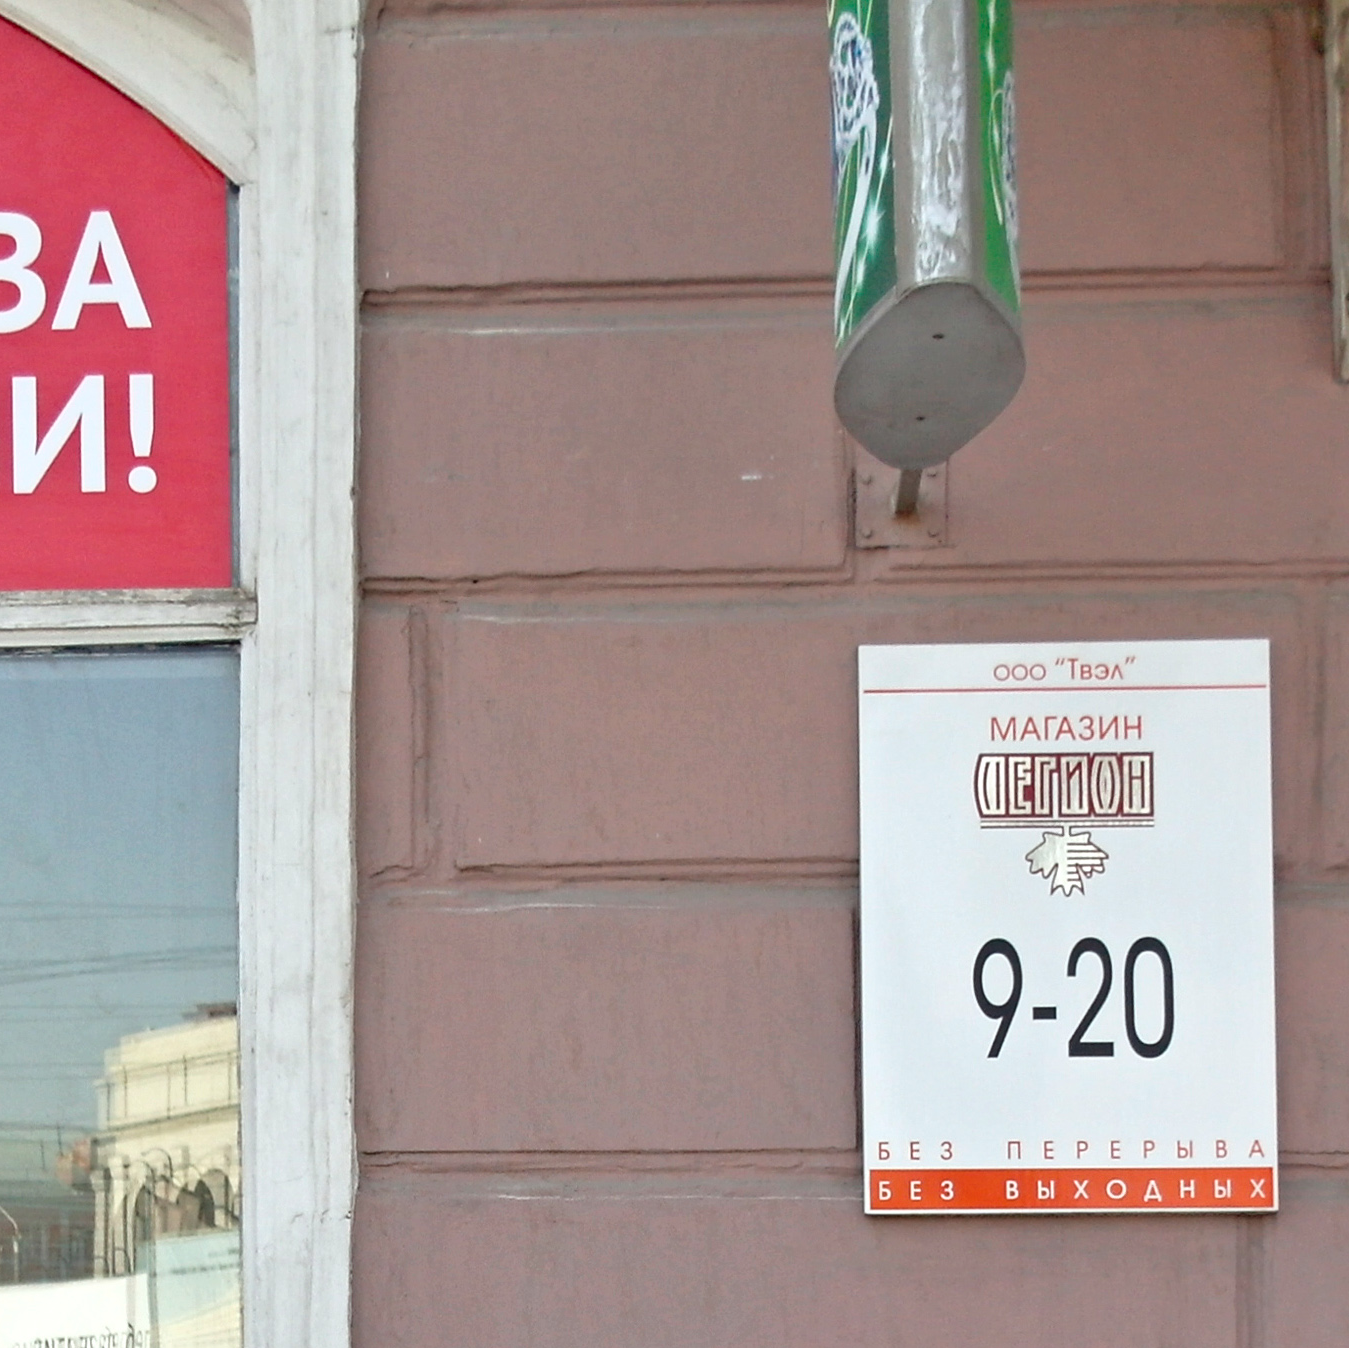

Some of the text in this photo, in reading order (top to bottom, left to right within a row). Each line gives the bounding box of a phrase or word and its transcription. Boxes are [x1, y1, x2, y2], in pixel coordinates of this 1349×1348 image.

[991, 716, 1141, 741] МАГАЗИН
[973, 937, 1174, 1058] 9-20
[879, 1140, 1264, 1160] БЕЗ ПЕРЕРЫВА
[879, 1179, 1265, 1202] БЕЗ ВЫХОДНЫХ
